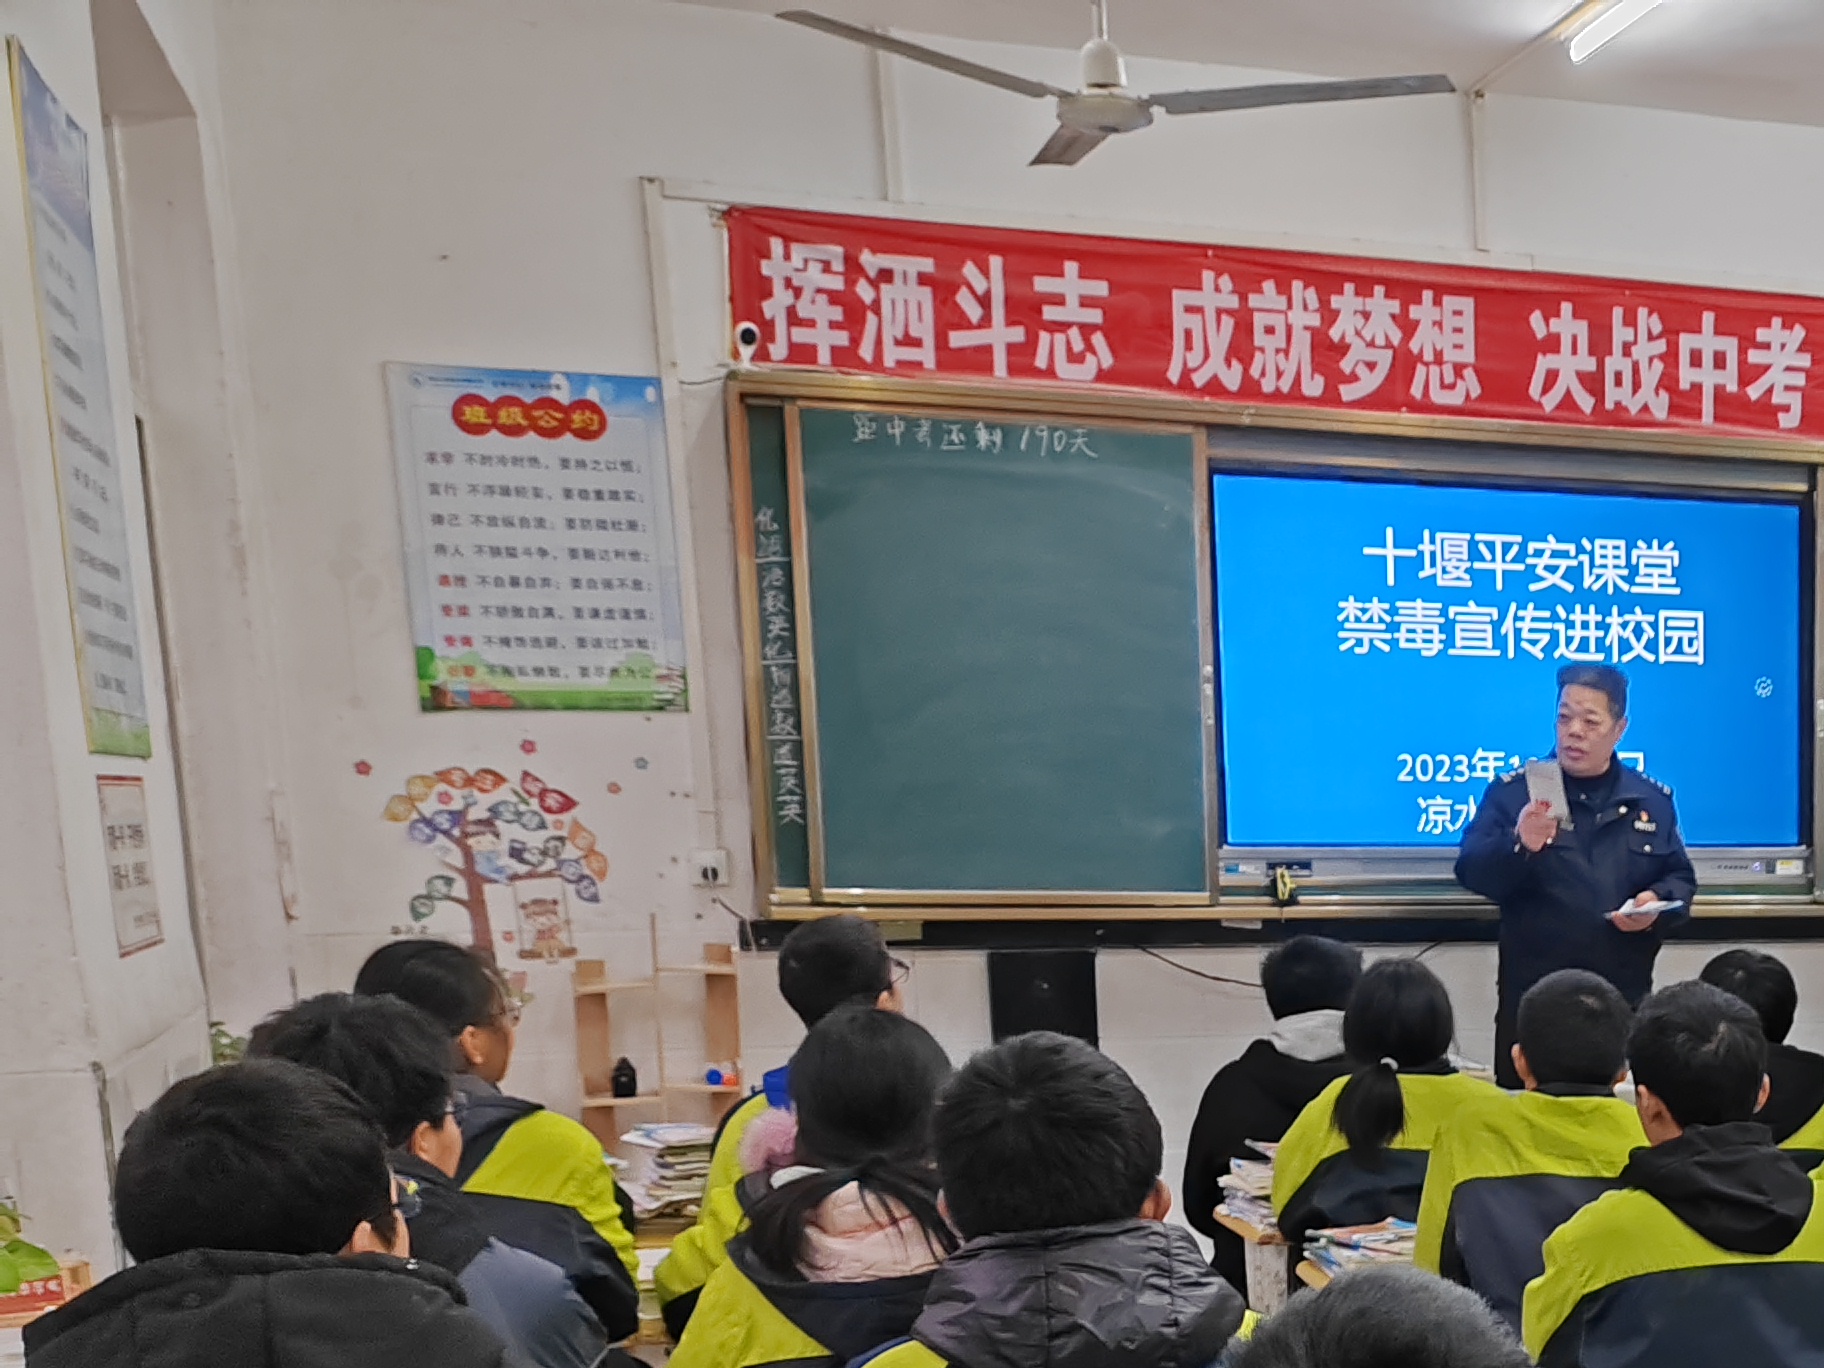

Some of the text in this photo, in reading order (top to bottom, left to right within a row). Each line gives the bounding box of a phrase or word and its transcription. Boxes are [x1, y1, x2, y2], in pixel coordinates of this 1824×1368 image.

[759, 236, 1116, 383] 挥洒斗志
[1166, 270, 1482, 406] 成就梦想
[1528, 300, 1813, 430] 决战中考
[461, 403, 601, 432] 班级公约
[1362, 525, 1682, 597] 十堰平安课堂
[1337, 596, 1706, 666] 禁毒宣传进校园
